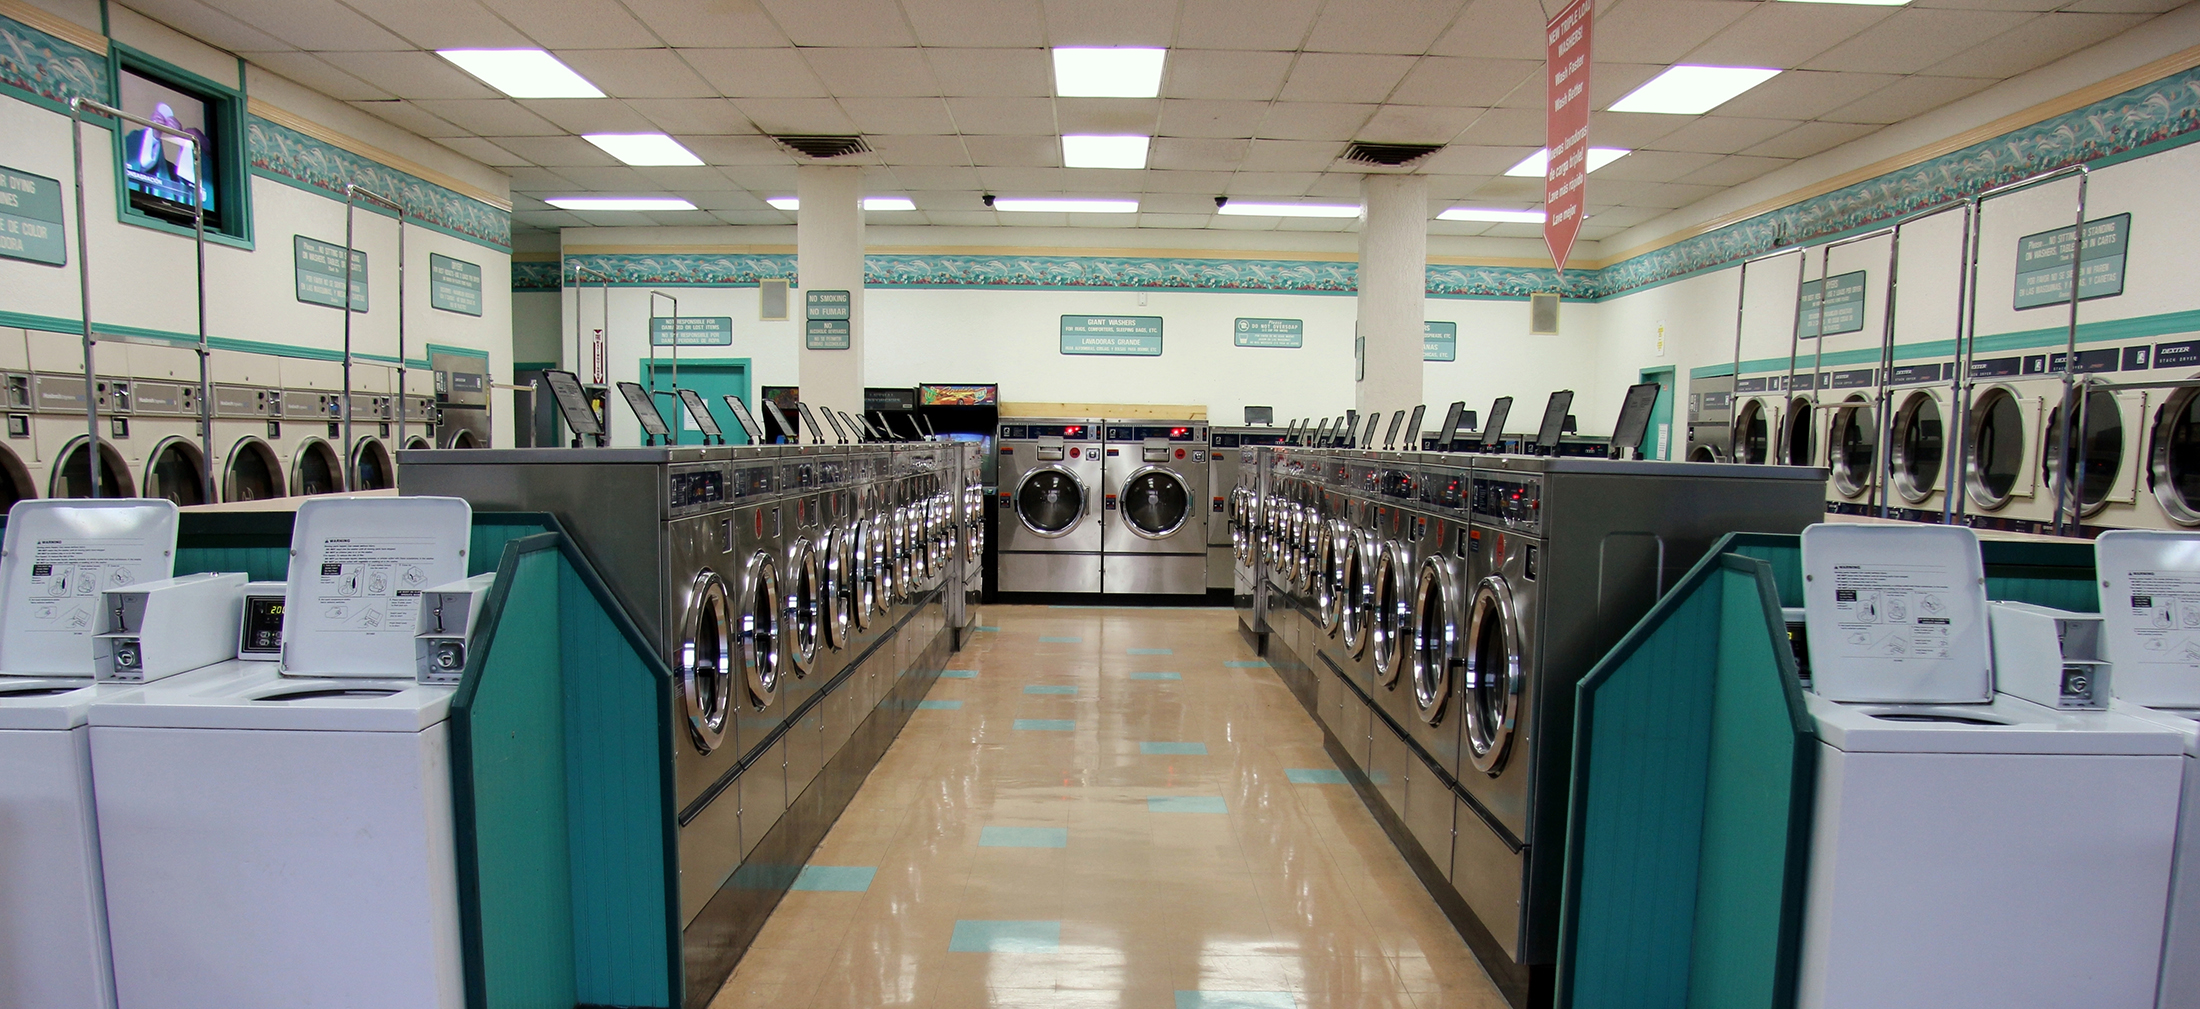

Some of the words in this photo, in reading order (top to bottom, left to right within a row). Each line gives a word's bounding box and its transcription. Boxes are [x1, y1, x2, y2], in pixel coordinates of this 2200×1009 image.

[1549, 27, 1561, 47] NEW
[1561, 9, 1578, 36] TRIPLE
[1555, 66, 1568, 86] Wash
[1569, 54, 1584, 76] Faster
[1555, 93, 1568, 112] Wash
[1568, 82, 1584, 102] Better
[1565, 125, 1587, 150] lavadoras
[1549, 168, 1555, 181] de
[1556, 161, 1569, 176] carga
[9, 175, 36, 194] DYING
[1548, 190, 1558, 204] Lave
[1553, 212, 1563, 226] Lave
[1563, 204, 1577, 220] mejor
[7, 220, 20, 234] DE
[21, 222, 48, 239] COLOR
[2088, 222, 2116, 237] STANDING
[2025, 251, 2033, 261] ON
[2097, 234, 2117, 246] CARTS
[2160, 346, 2190, 354] DEXTER
